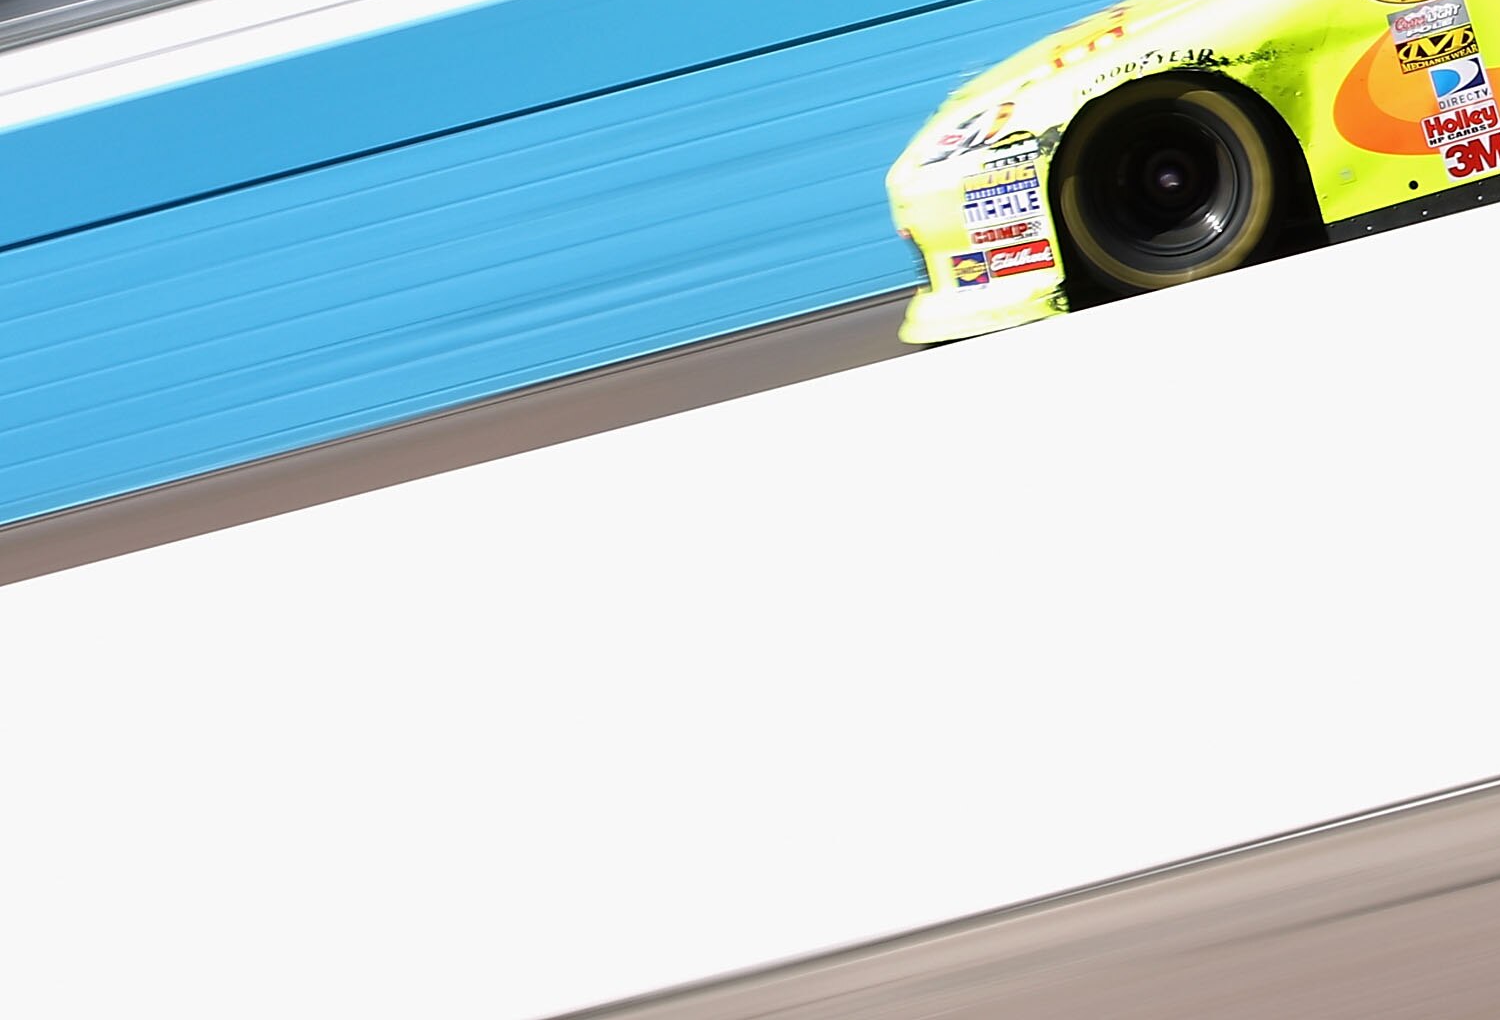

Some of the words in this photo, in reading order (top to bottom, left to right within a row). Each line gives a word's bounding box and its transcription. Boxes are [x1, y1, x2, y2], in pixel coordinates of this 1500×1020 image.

[1427, 3, 1461, 22] LIGHT
[1402, 56, 1451, 72] MECHANIX
[1451, 45, 1478, 59] WEAR
[1438, 88, 1488, 110] DIRECTV
[1424, 105, 1498, 139] Holley
[1429, 137, 1445, 146] HP
[1447, 124, 1487, 140] CARBS
[964, 191, 1040, 222] MAHLE
